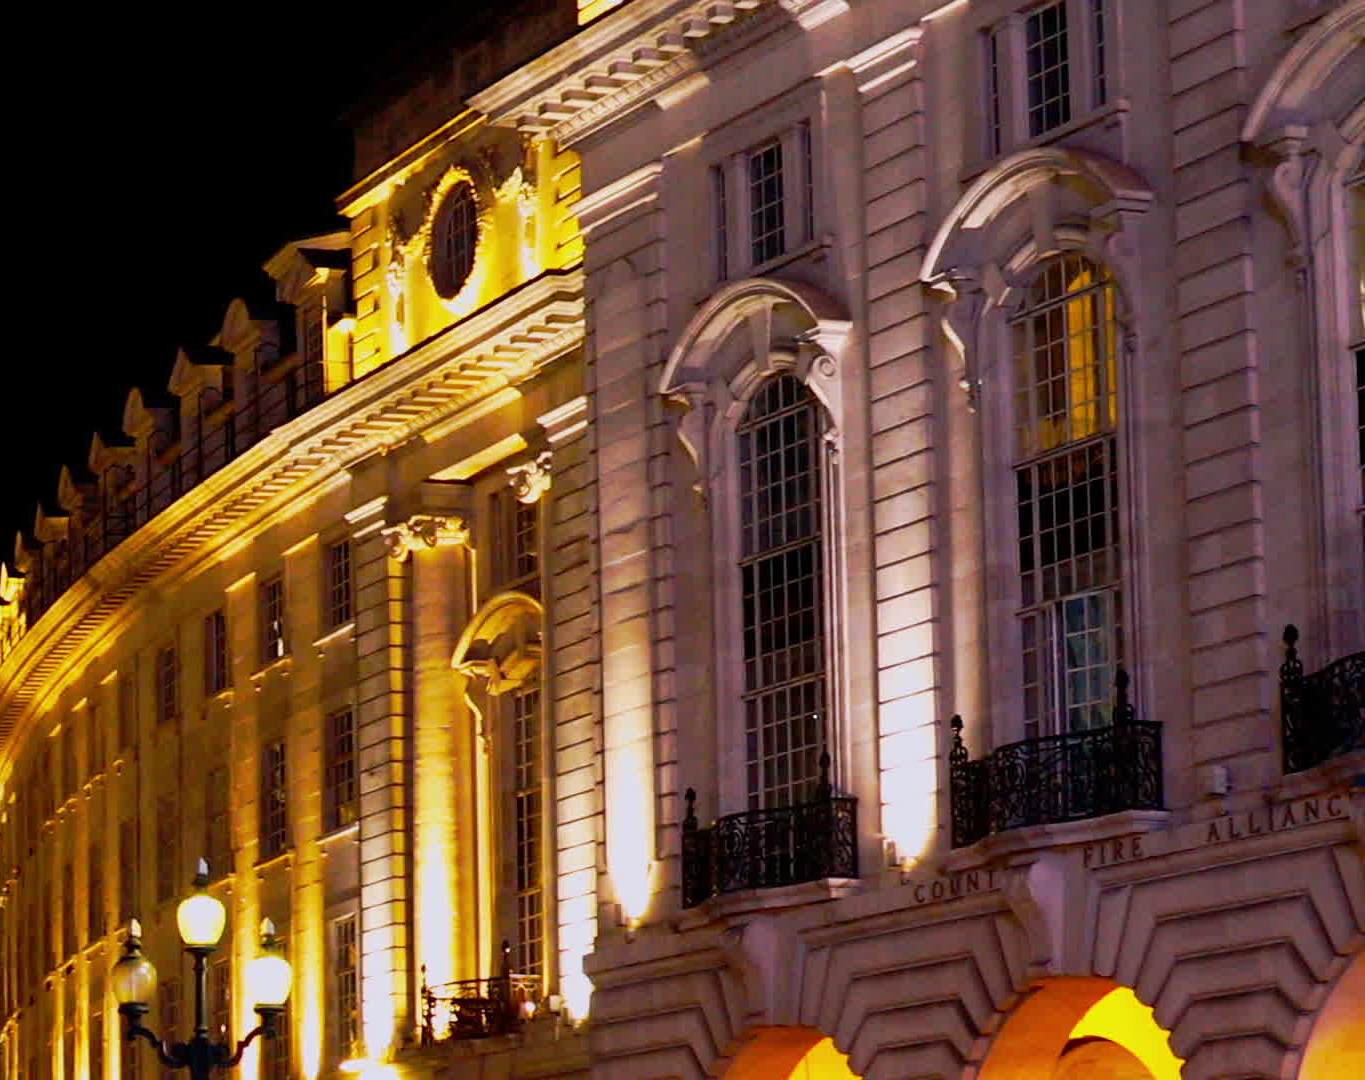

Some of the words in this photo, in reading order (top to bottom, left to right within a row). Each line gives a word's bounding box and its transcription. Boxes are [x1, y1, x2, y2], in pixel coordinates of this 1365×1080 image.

[1207, 794, 1342, 842] ALLIANC
[1082, 836, 1143, 869] FIRE
[914, 870, 995, 903] COUNT
